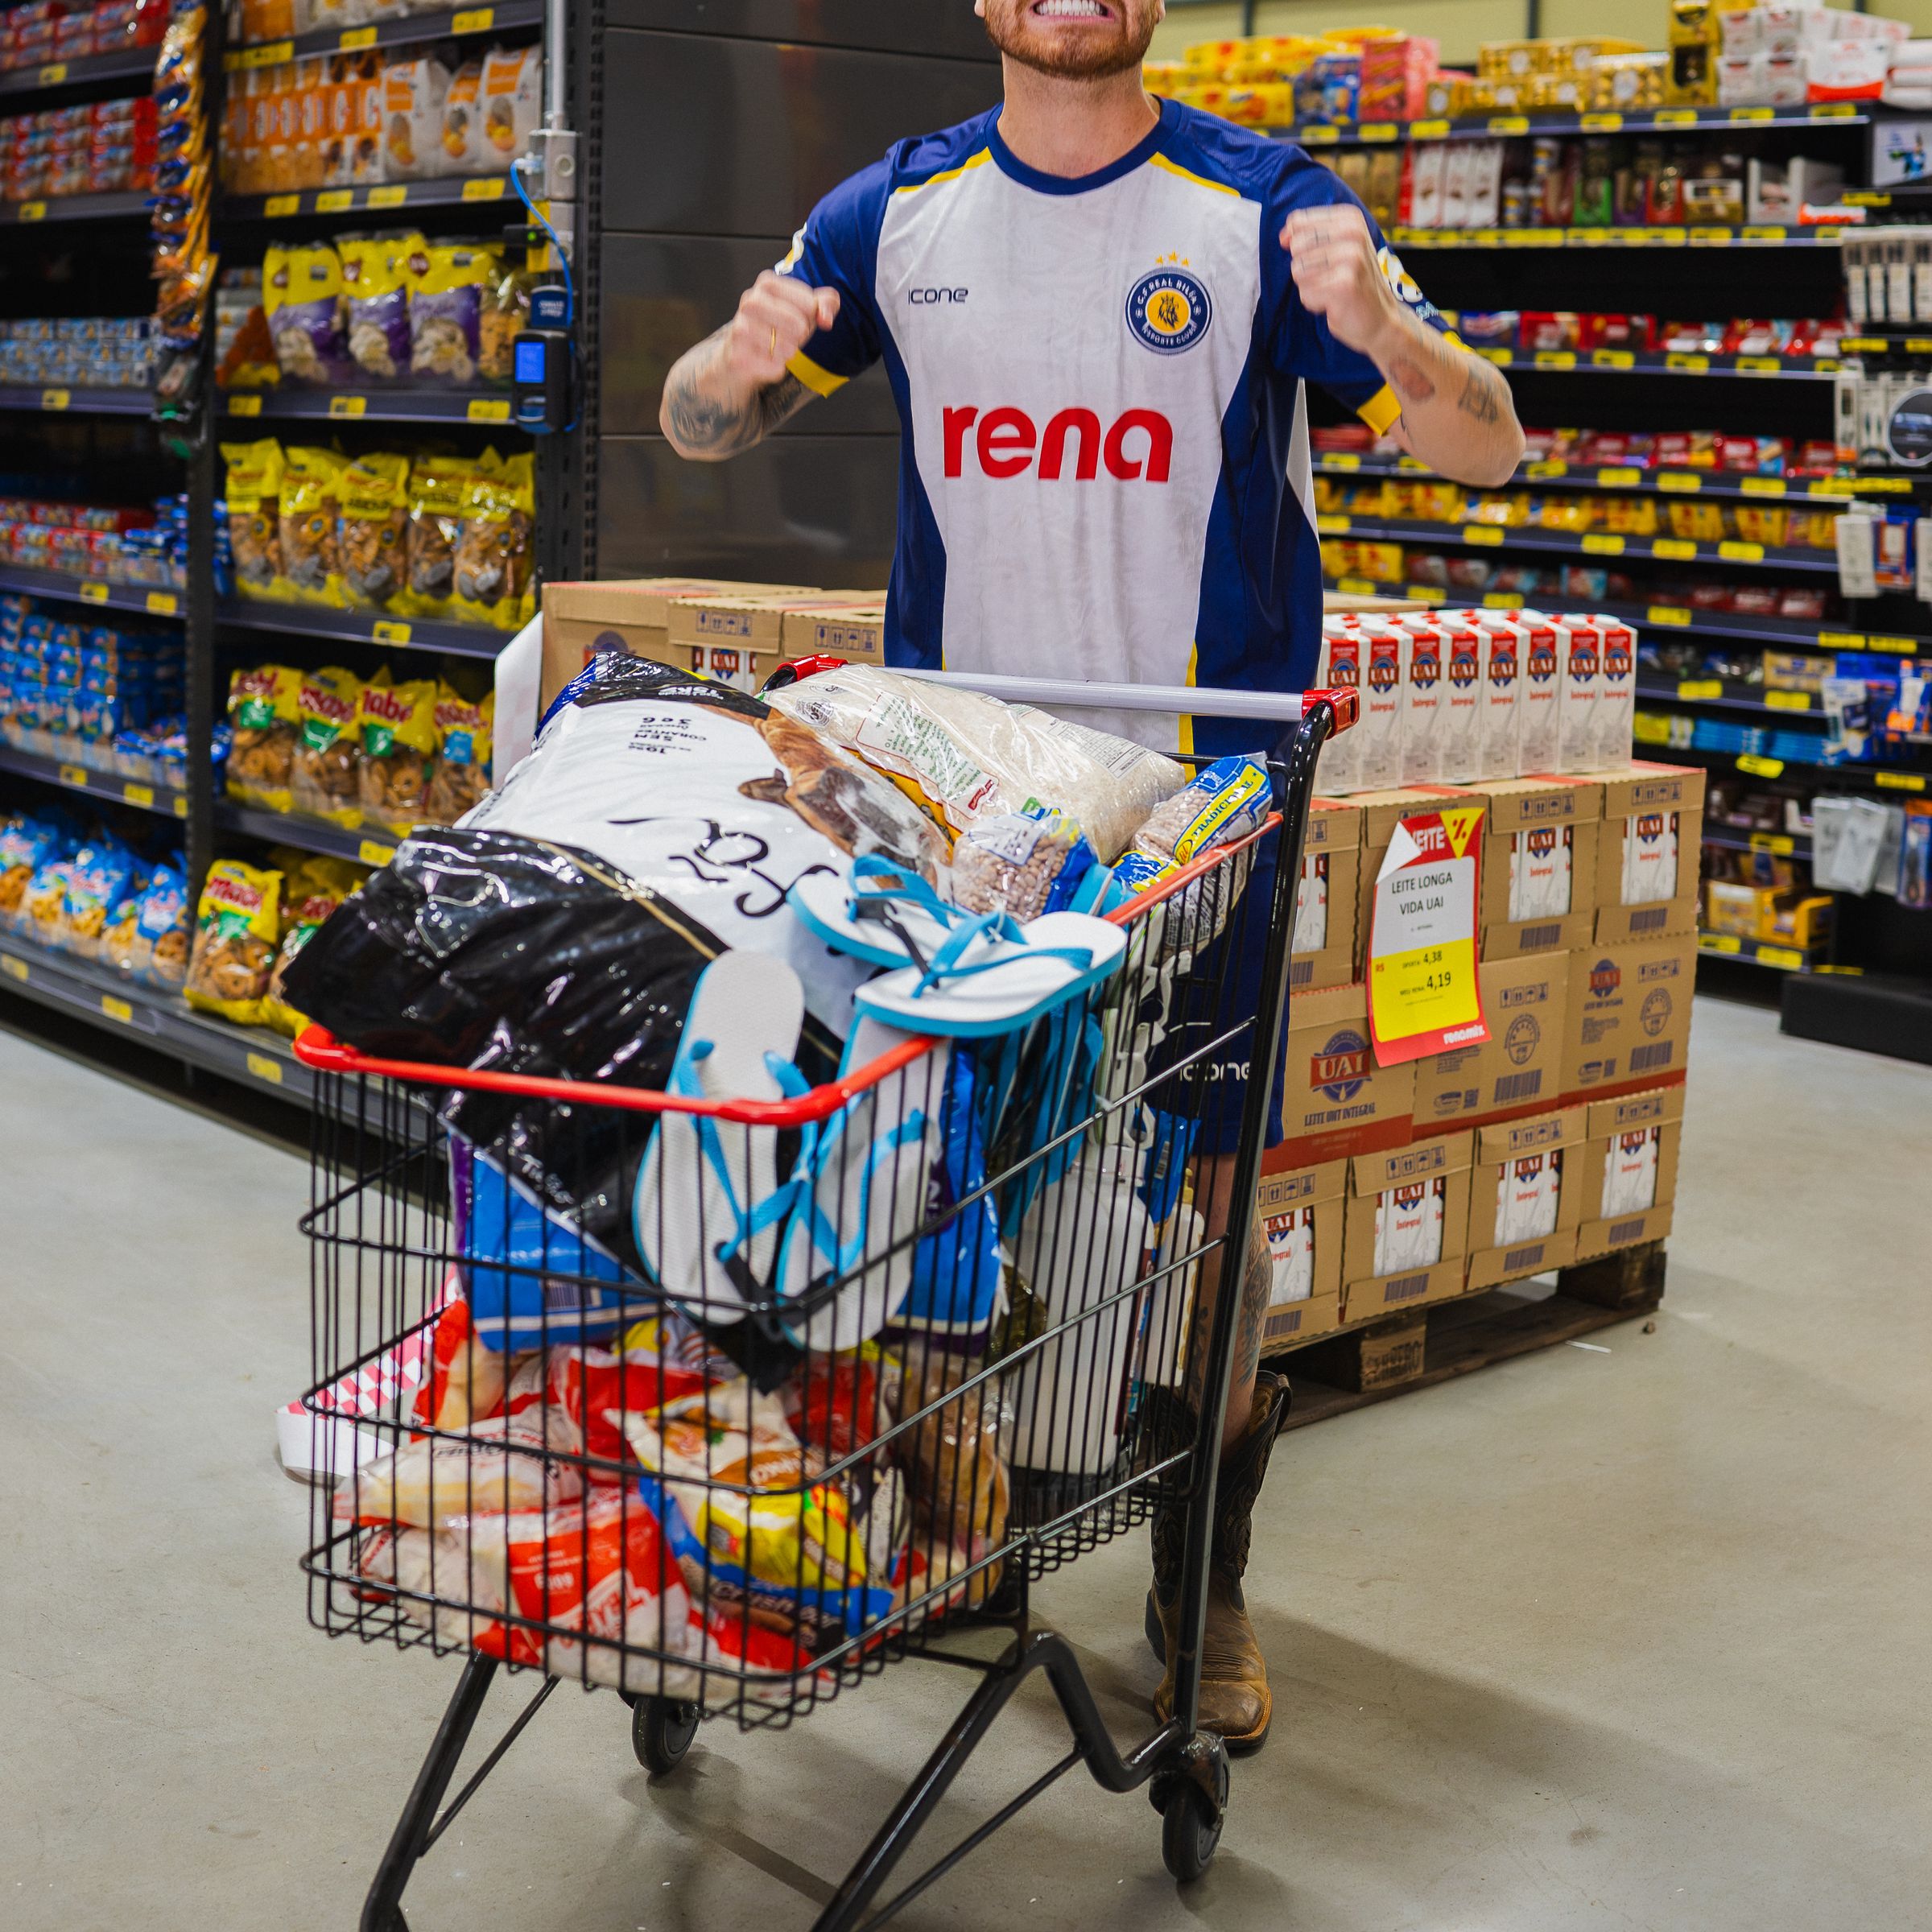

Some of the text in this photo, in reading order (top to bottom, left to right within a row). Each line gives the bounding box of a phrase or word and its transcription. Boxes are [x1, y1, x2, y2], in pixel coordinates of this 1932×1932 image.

[943, 405, 1173, 483] rena
[1392, 872, 1453, 894] LEITE LONGA
[1400, 896, 1444, 915] VIDA UAI
[1423, 950, 1443, 965] 4,38
[1426, 971, 1452, 992] 4,19
[1318, 1054, 1364, 1081] UAI
[1304, 1112, 1325, 1127] LEITE
